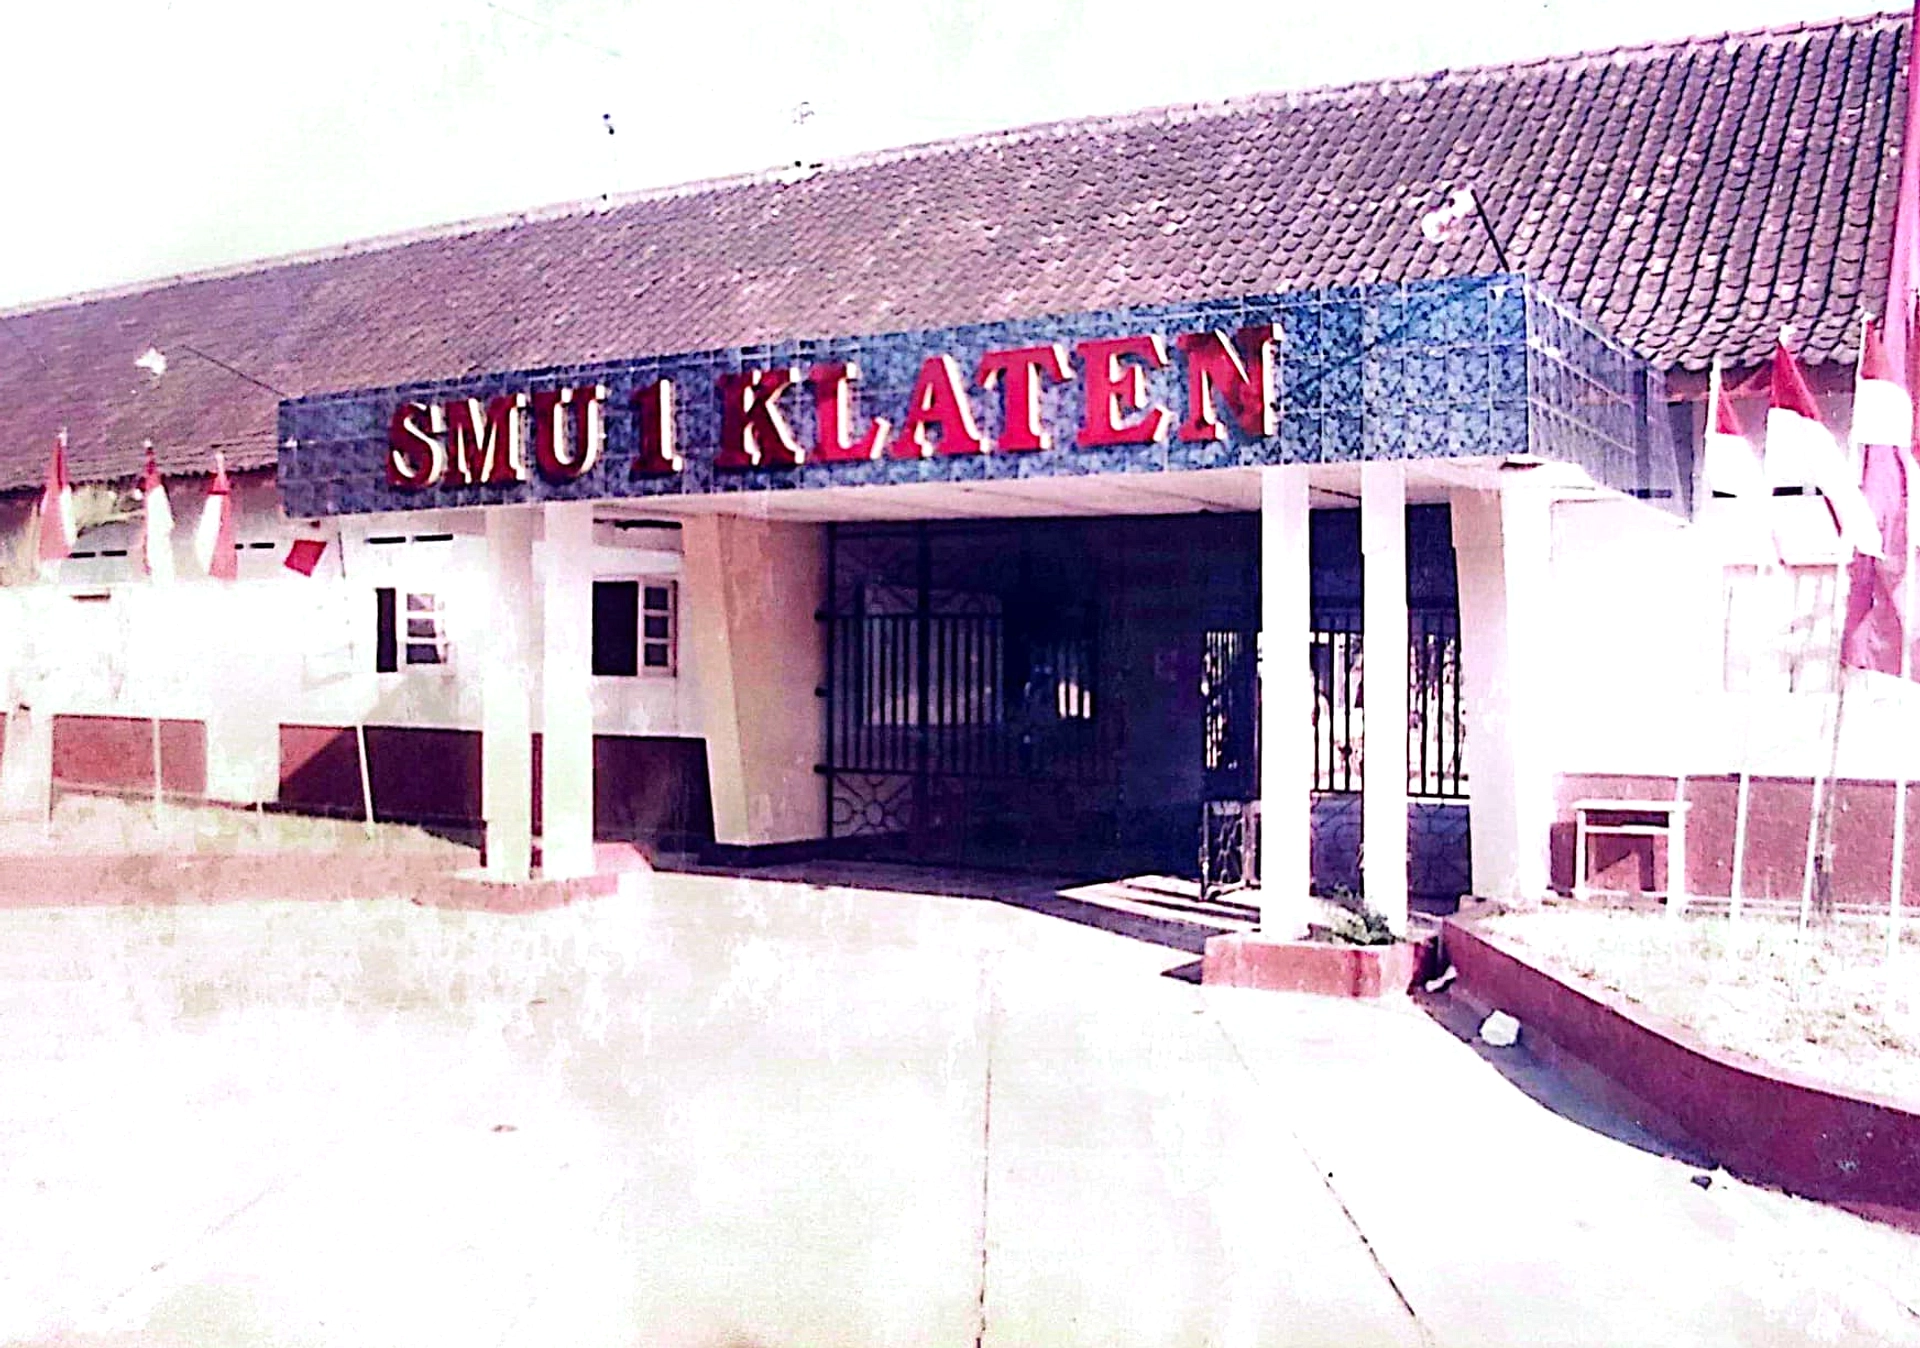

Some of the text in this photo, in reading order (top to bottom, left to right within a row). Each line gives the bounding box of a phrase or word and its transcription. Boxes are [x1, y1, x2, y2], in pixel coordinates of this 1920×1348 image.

[386, 323, 1283, 489] SMU 1 KLATEN
